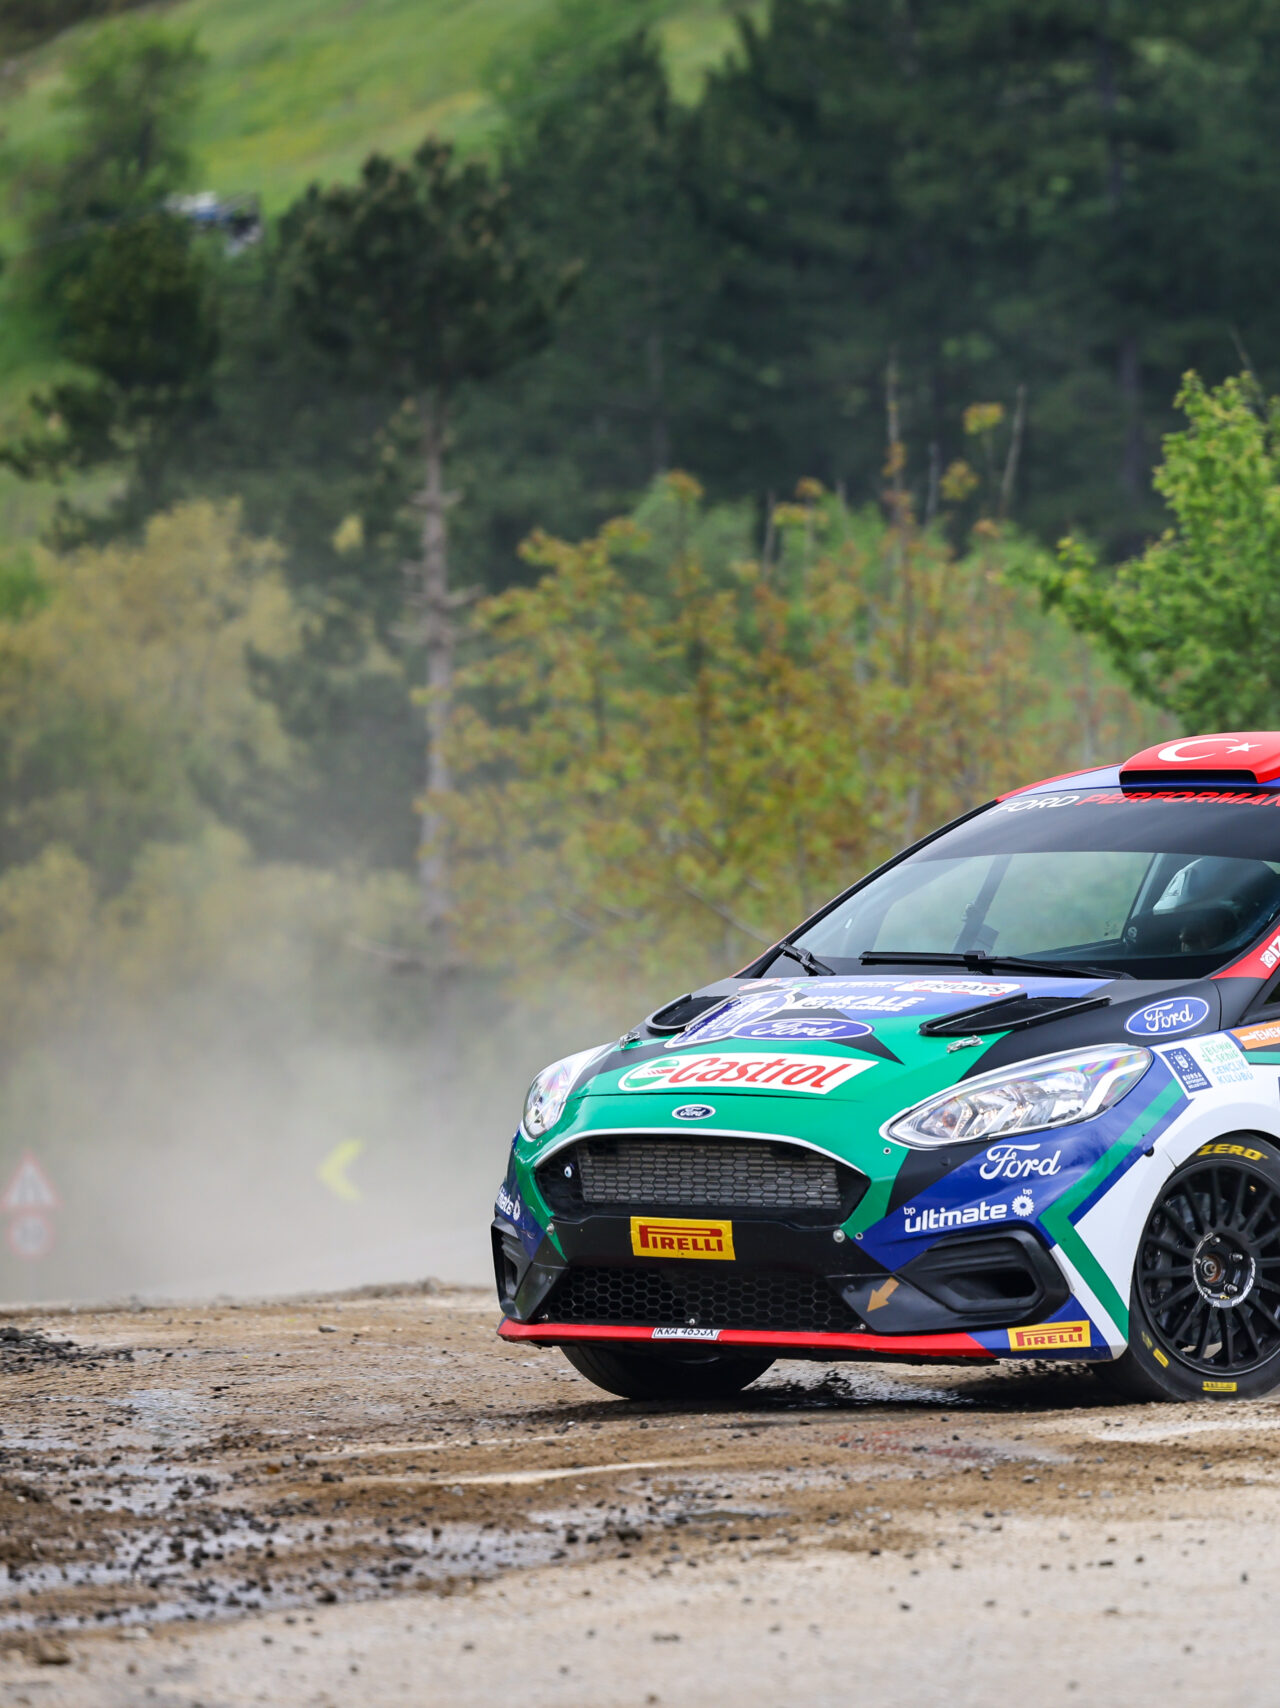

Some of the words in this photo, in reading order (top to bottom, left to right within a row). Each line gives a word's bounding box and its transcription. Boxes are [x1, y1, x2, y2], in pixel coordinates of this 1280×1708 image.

[989, 795, 1080, 816] FORD
[1144, 1003, 1194, 1032] Ford
[751, 1021, 846, 1037] Ford
[668, 1057, 853, 1089] Castrol
[680, 1107, 707, 1118] Ford
[979, 1143, 1062, 1180] Ford
[1197, 1143, 1263, 1161] ZERO
[903, 1206, 916, 1217] bp
[904, 1201, 1008, 1233] ultimate
[639, 1225, 724, 1252] PIRELLI
[1016, 1326, 1083, 1347] PIRELLI
